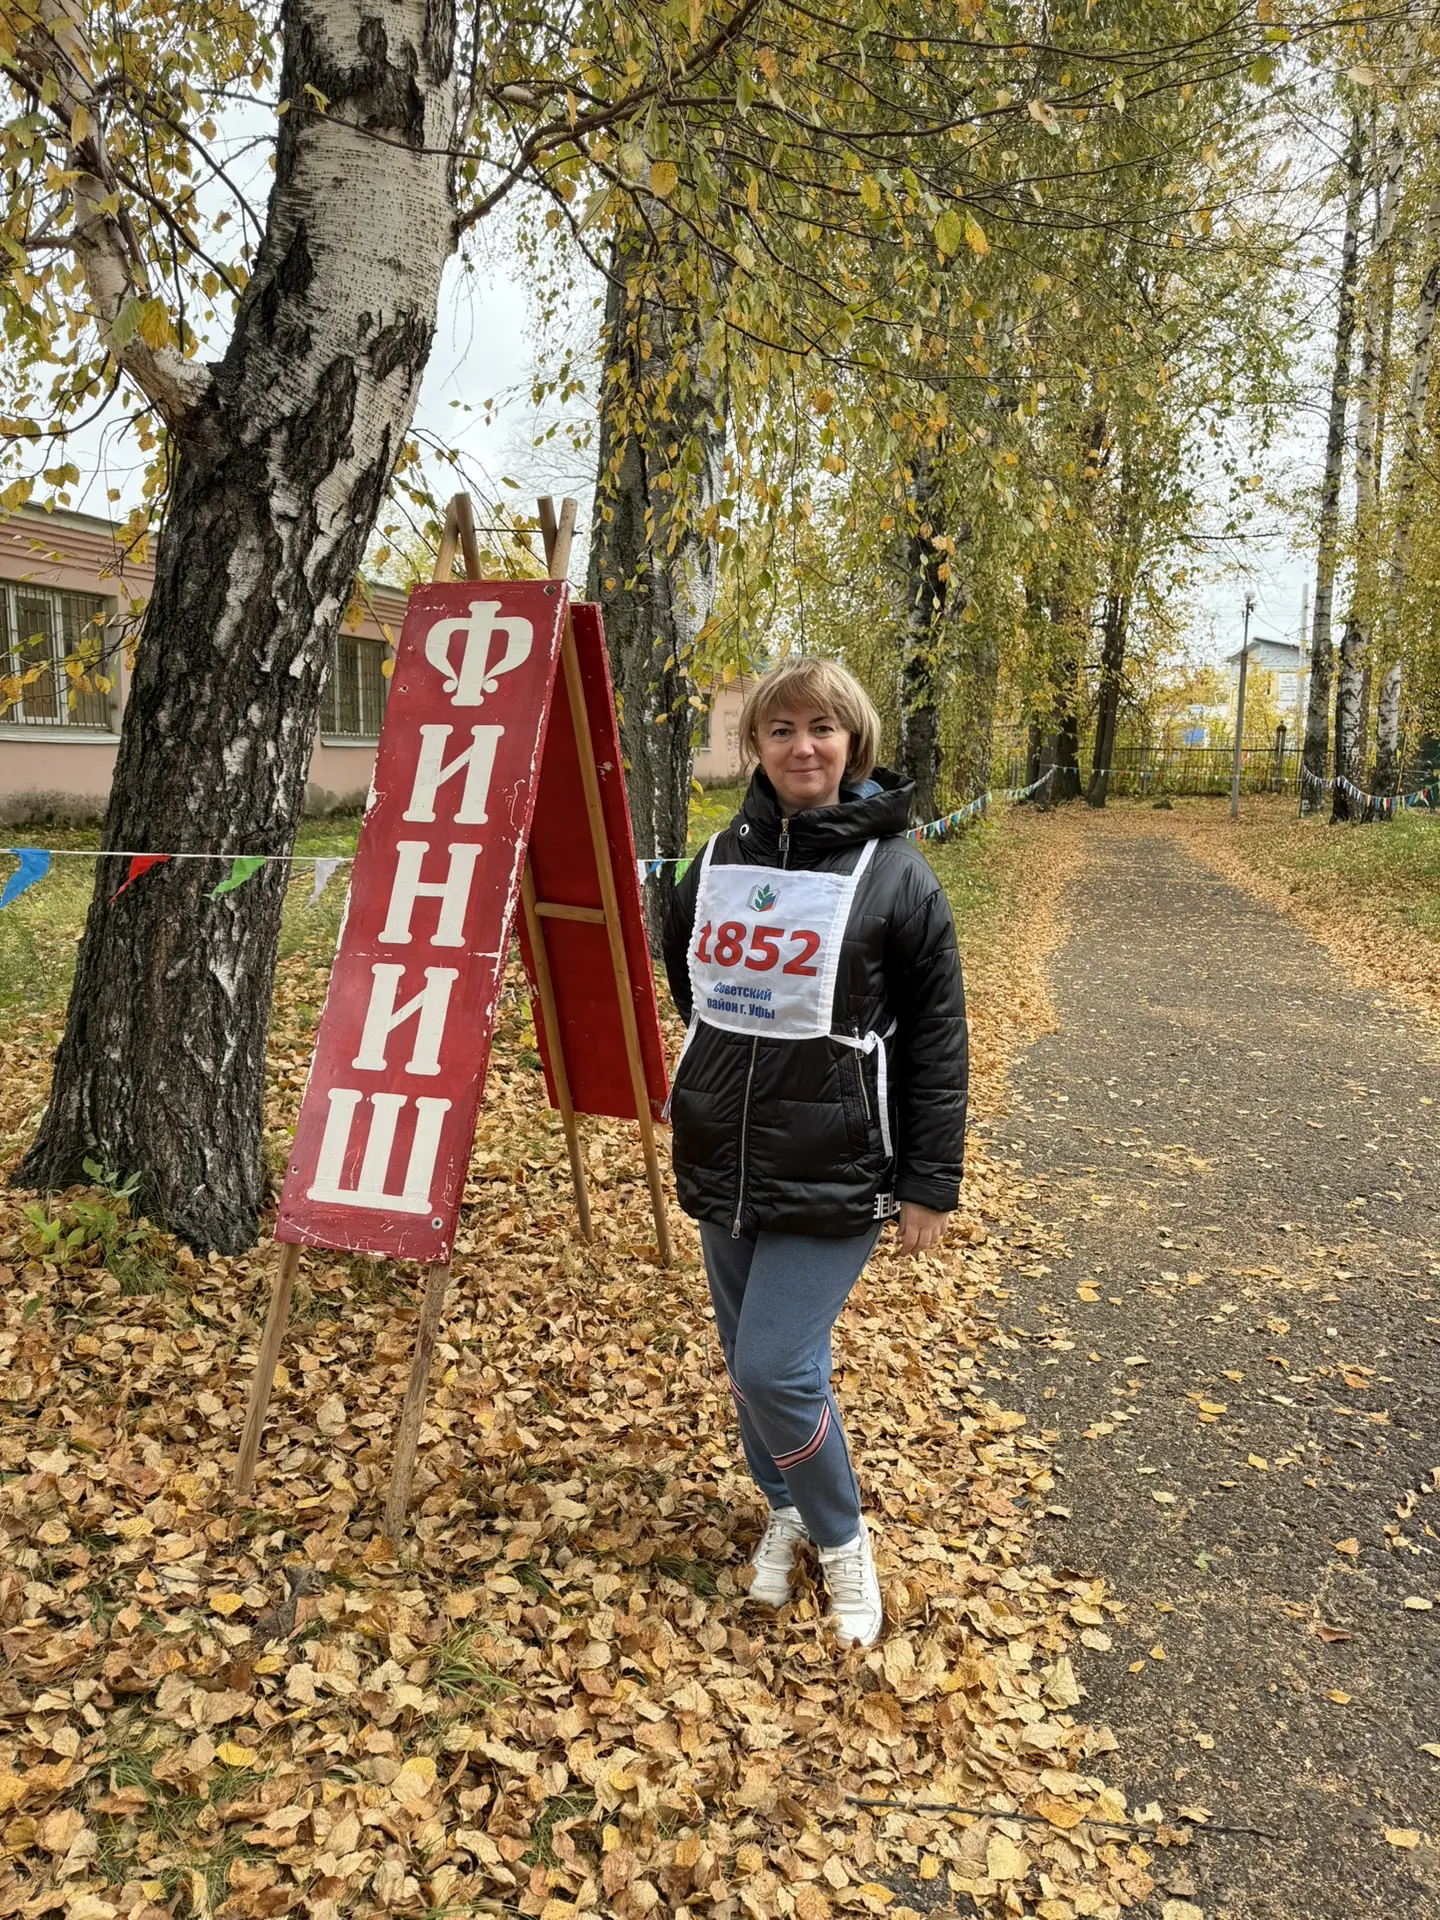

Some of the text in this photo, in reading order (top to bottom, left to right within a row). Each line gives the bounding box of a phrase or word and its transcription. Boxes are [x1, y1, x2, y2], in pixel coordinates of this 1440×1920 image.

[306, 600, 534, 1214] ФИНИШ
[694, 920, 821, 976] 1852
[713, 982, 772, 1001] Советский
[740, 1003, 747, 1015] г.
[748, 1003, 776, 1019] Уфы
